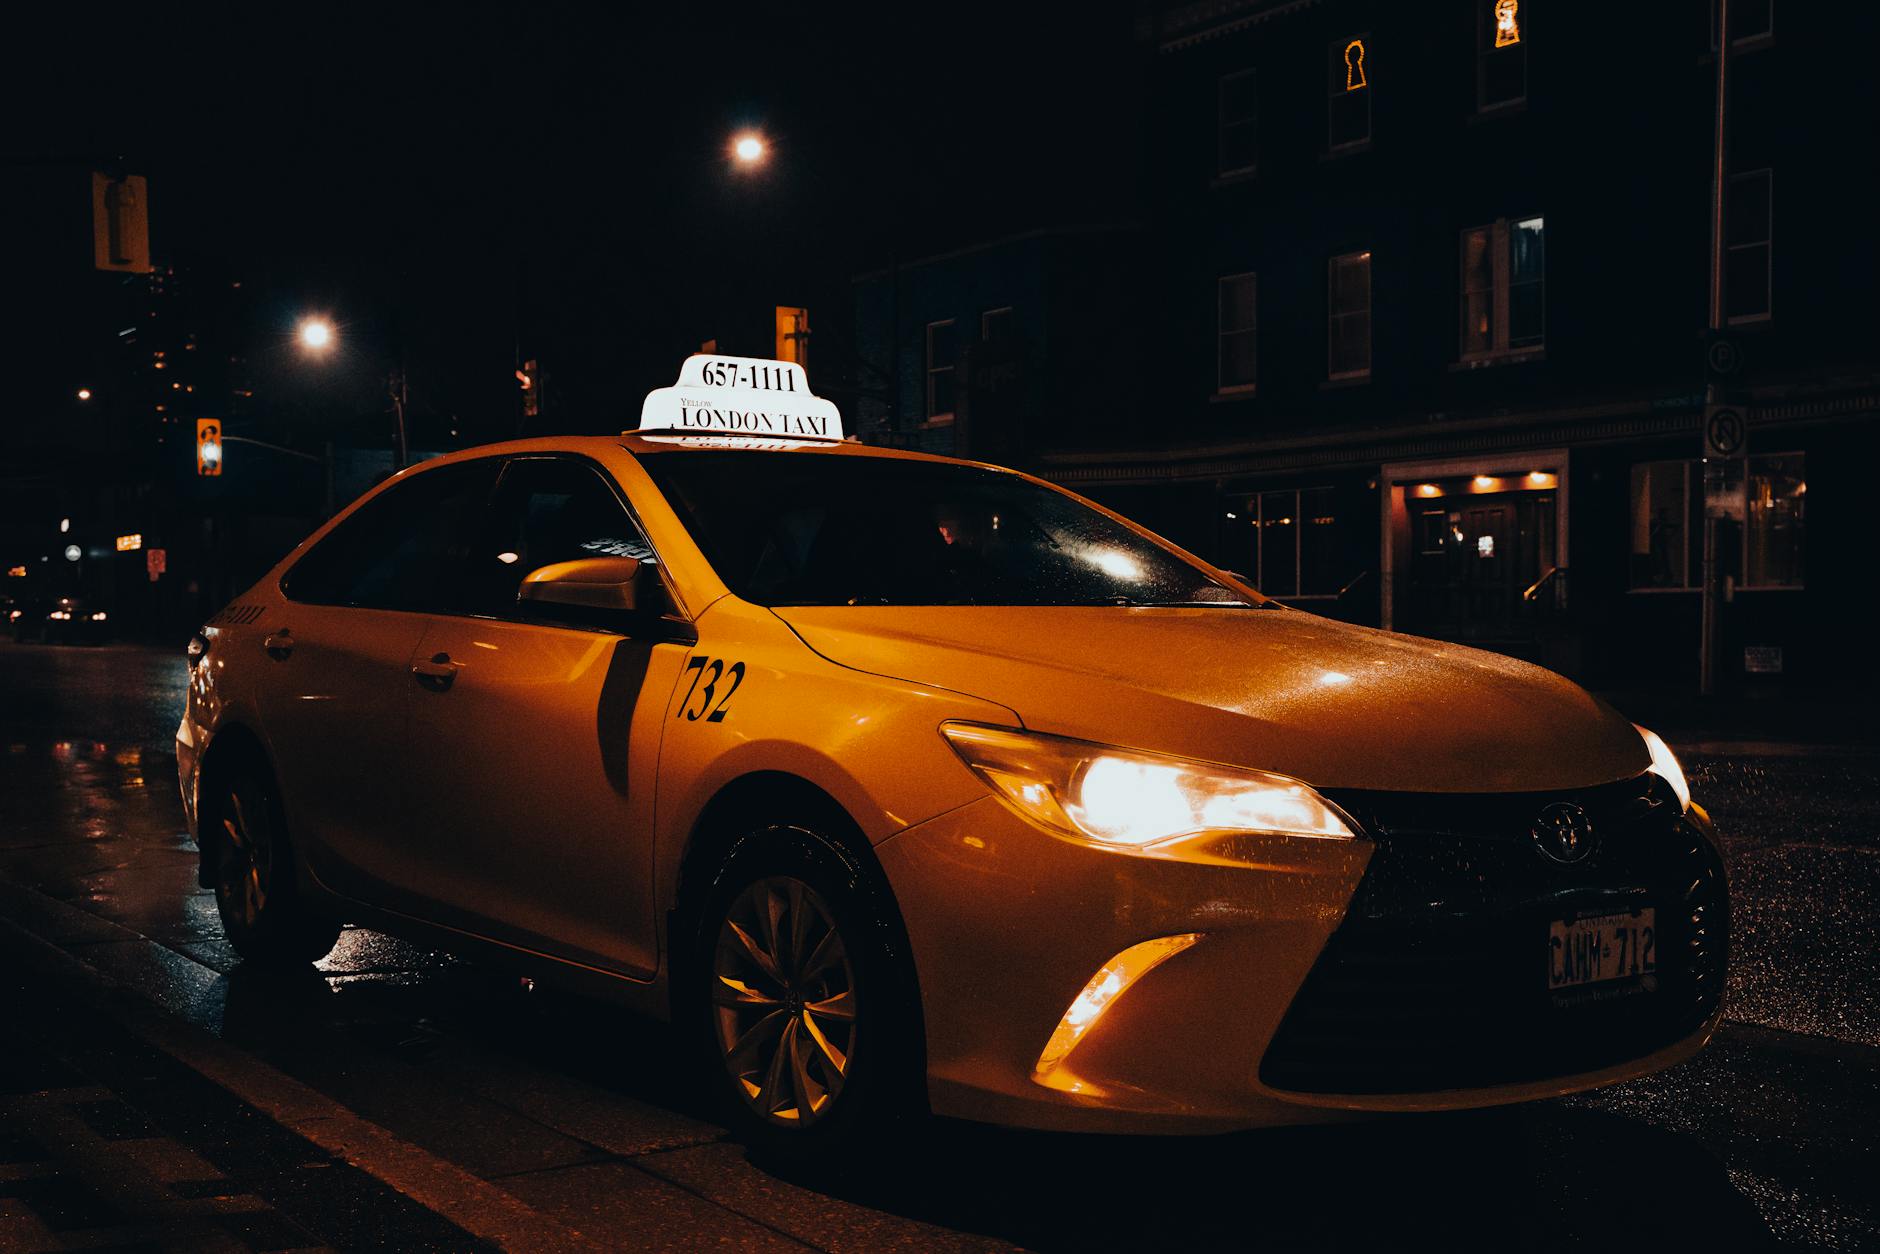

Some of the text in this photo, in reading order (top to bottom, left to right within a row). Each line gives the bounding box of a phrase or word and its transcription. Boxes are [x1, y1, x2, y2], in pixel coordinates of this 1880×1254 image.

[702, 361, 797, 392] 657-1111
[681, 407, 829, 436] LONDON TAXI
[677, 656, 746, 723] 732
[1549, 926, 1655, 985] CAHM 712
